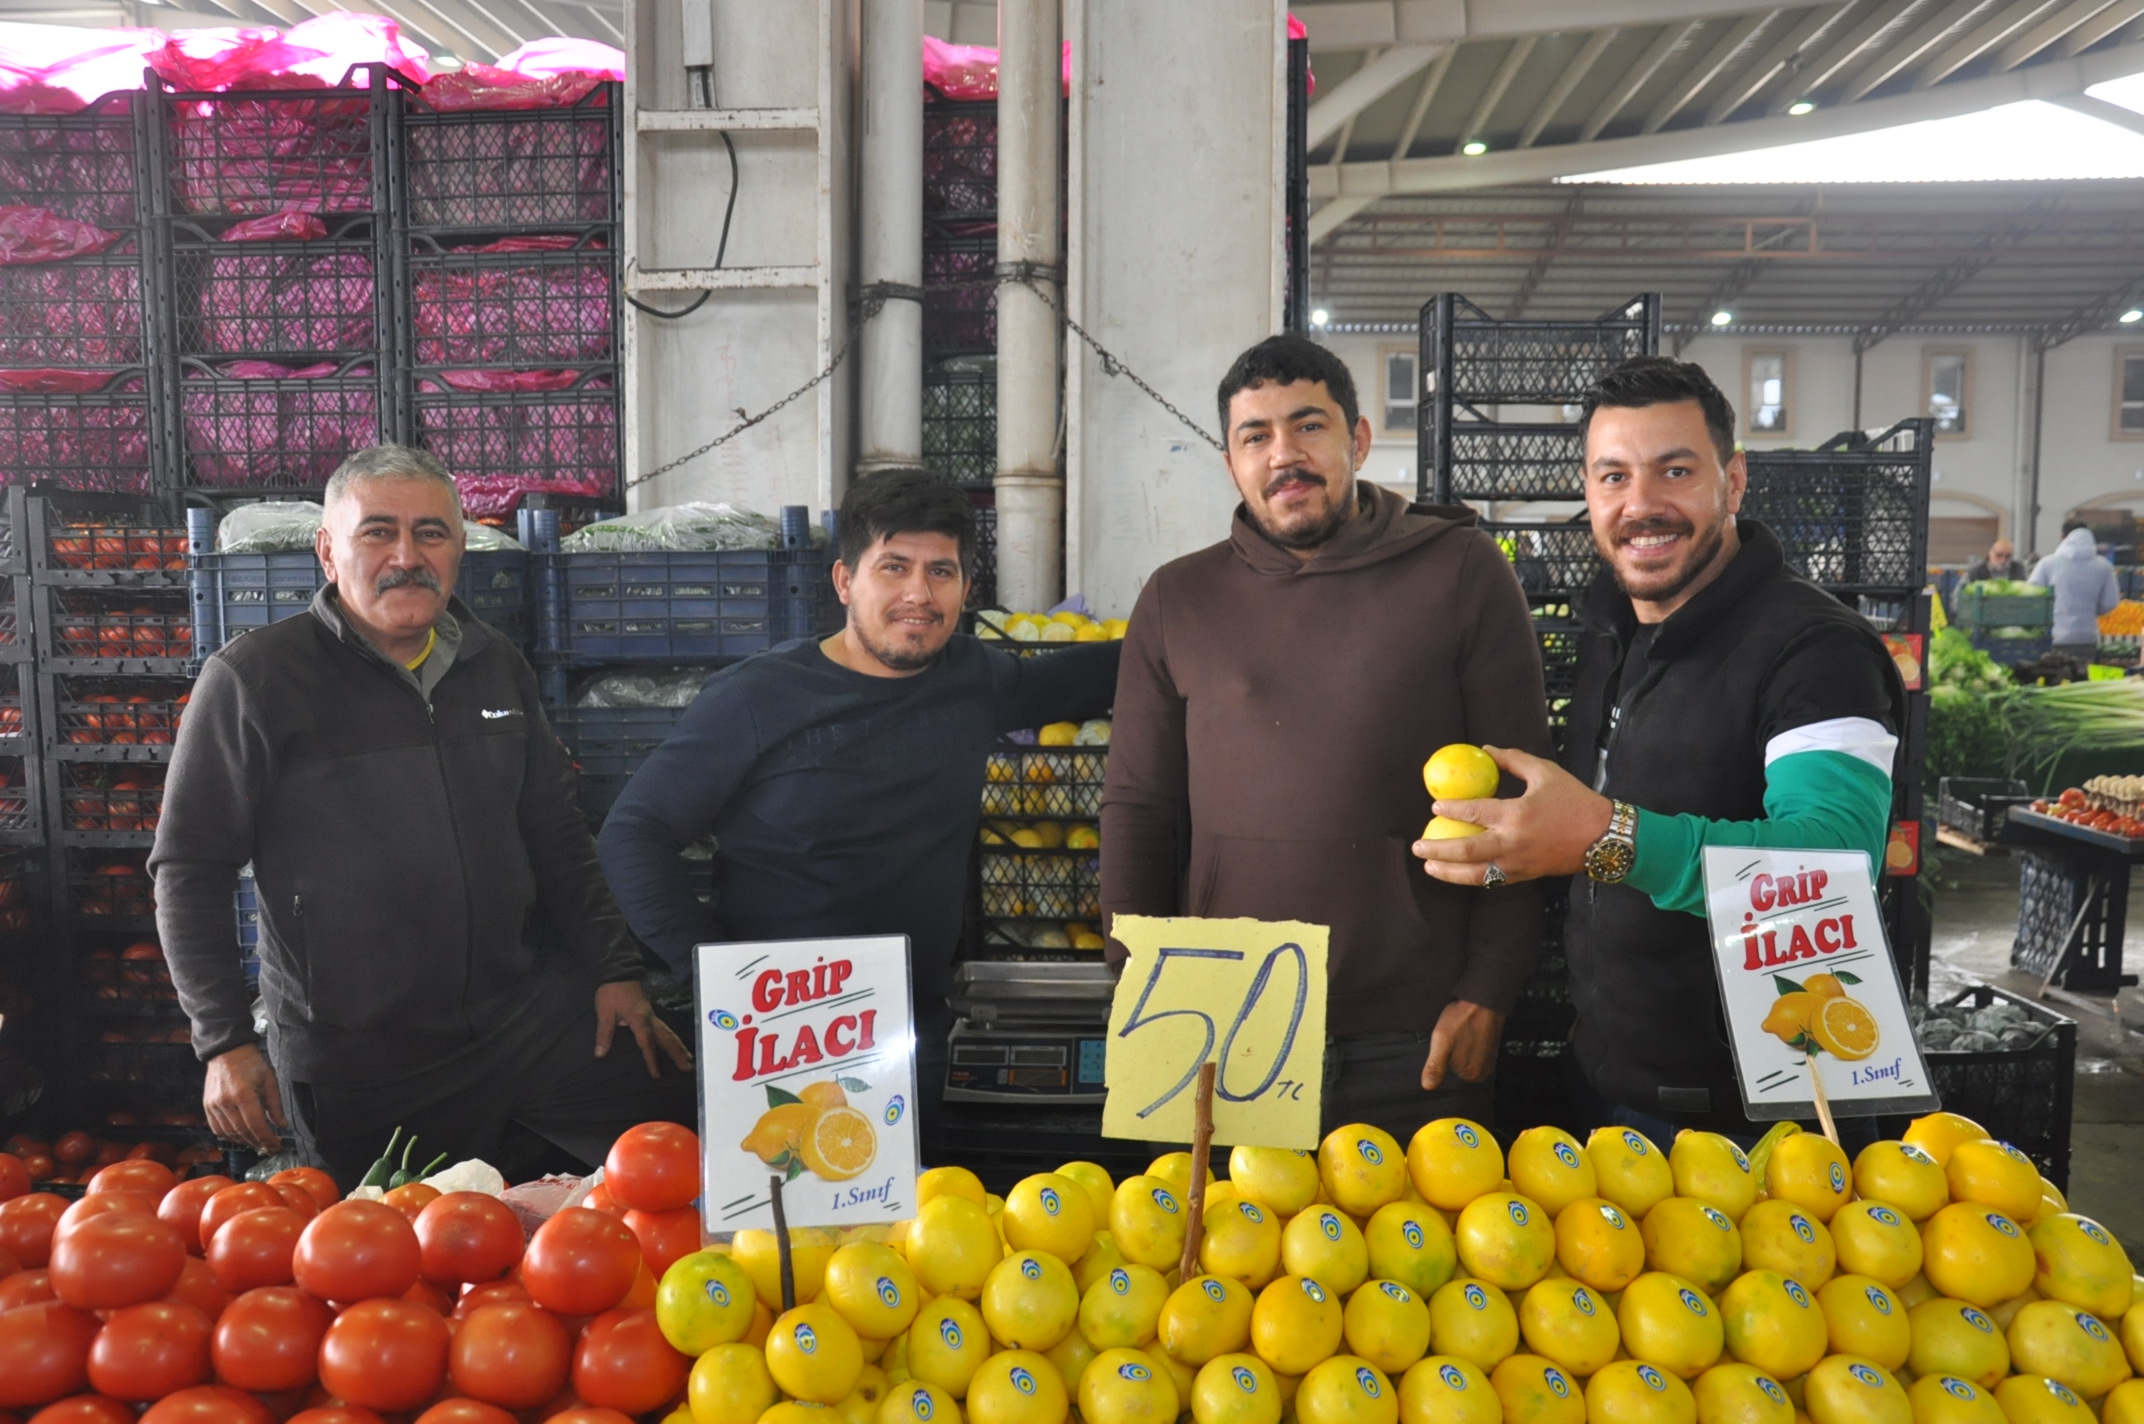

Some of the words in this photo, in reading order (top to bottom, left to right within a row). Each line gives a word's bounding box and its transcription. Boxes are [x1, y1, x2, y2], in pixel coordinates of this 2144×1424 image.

[1751, 865, 1828, 911] GRİP
[1740, 912, 1857, 970] İLACI
[752, 956, 853, 1013] GRİP
[732, 1009, 877, 1081] İLACI
[1118, 942, 1308, 1119] 50
